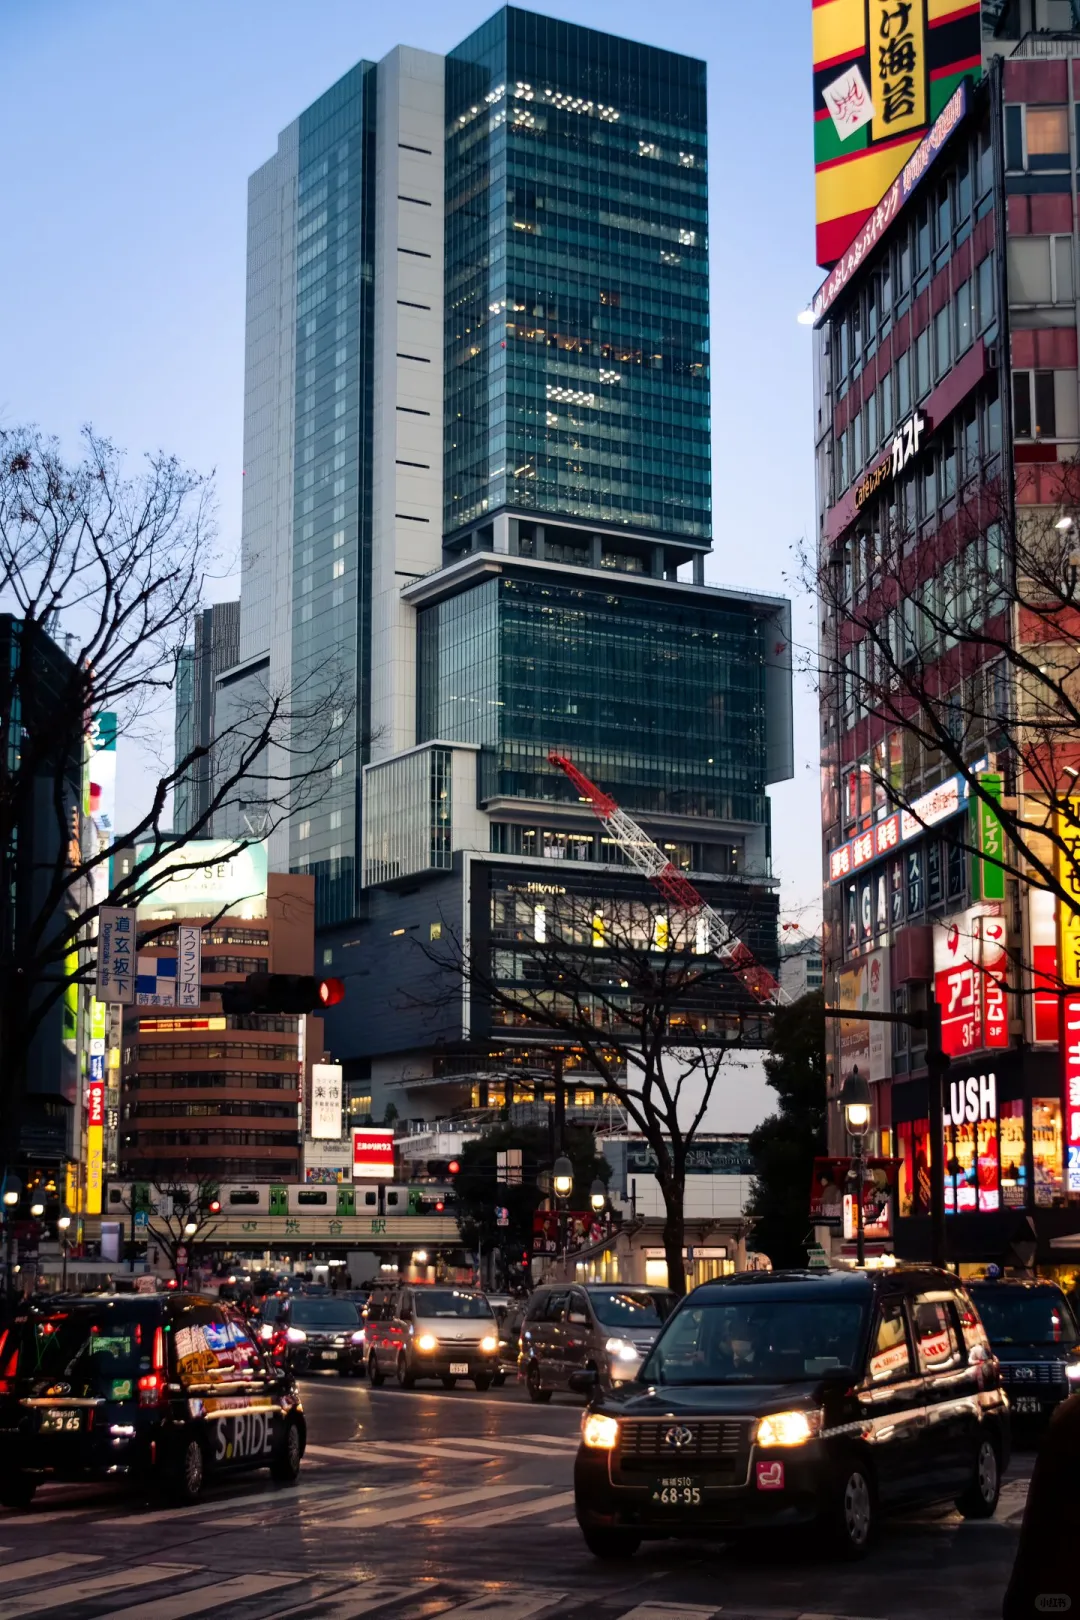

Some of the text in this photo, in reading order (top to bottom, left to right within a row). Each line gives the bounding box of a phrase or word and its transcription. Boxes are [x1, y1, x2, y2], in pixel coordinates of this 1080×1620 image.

[879, 0, 916, 124] け海苔
[891, 412, 924, 478] ガスト
[985, 815, 998, 854] レイク
[102, 923, 112, 964] Dogenzaka
[113, 916, 130, 995] 道玄坂下
[183, 930, 196, 1005] スクランブル式
[986, 971, 1004, 1021] アコム
[962, 1021, 974, 1047] 3F
[990, 1027, 1003, 1036] 3F
[314, 1086, 339, 1098] 楽待
[285, 1218, 386, 1235] 渋谷駅
[661, 1487, 701, 1504] 68-95
